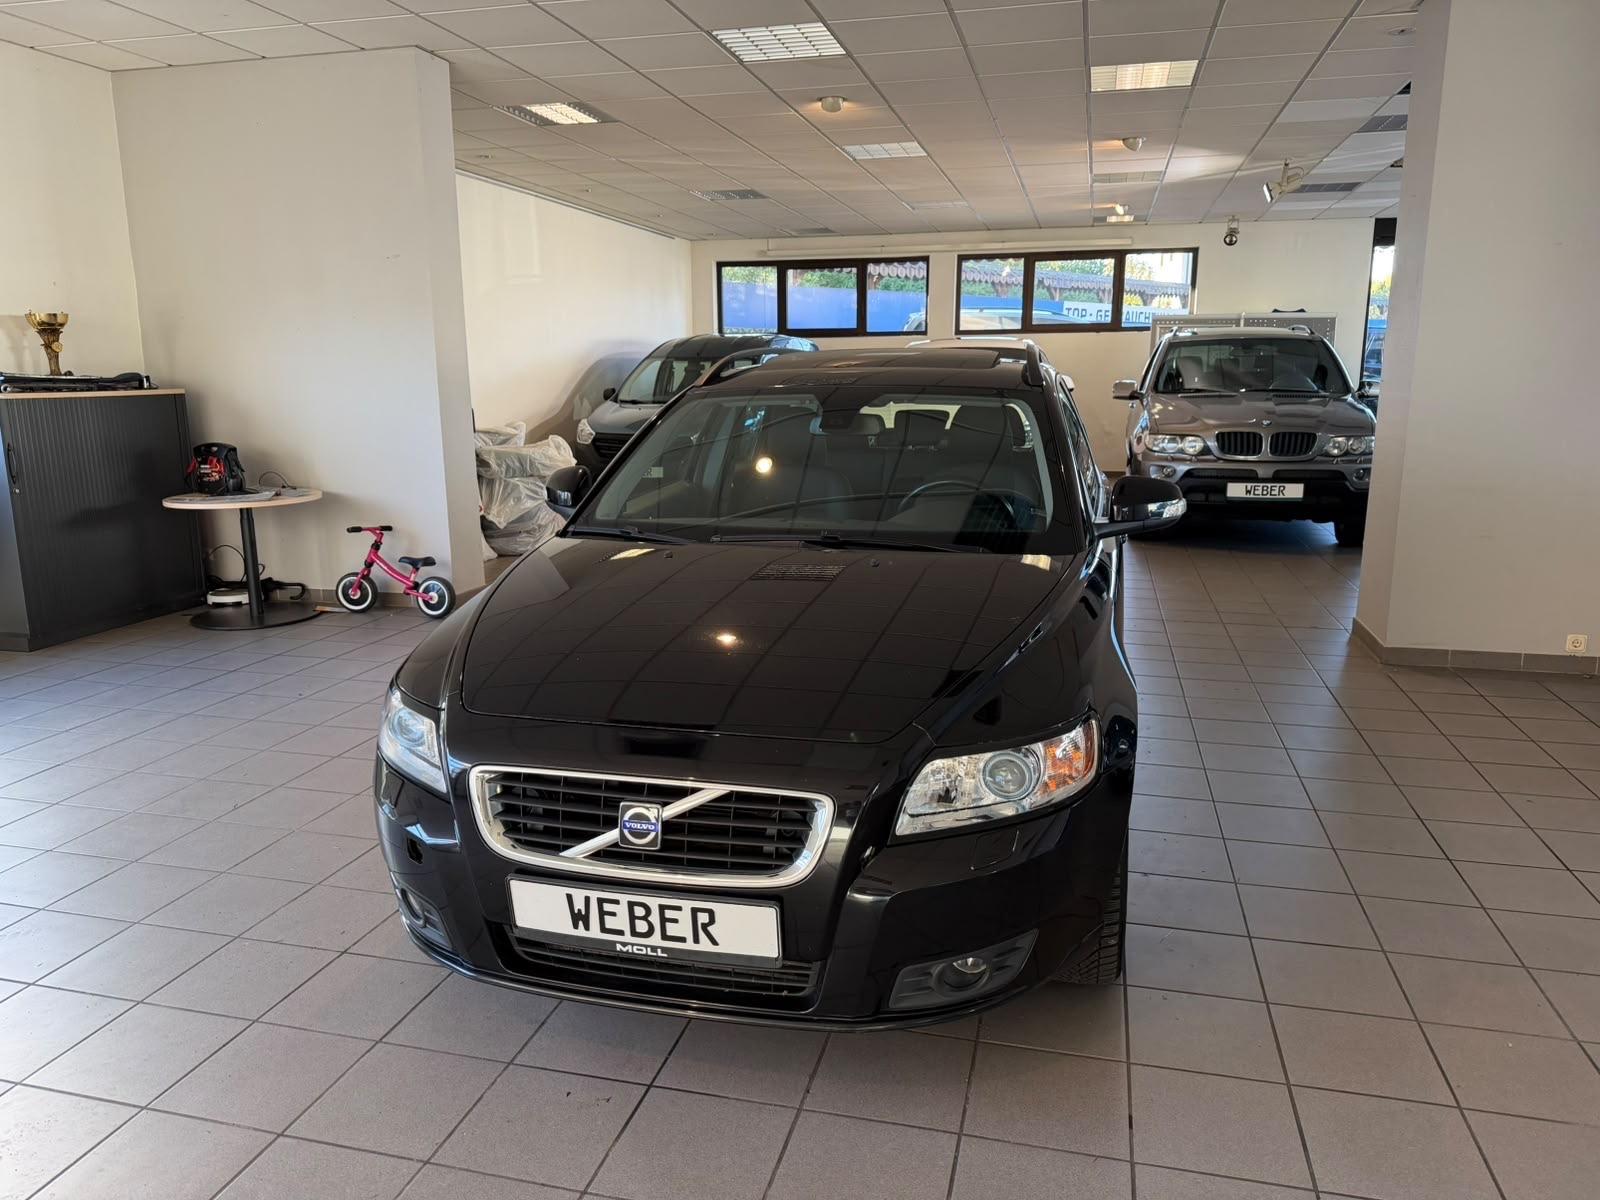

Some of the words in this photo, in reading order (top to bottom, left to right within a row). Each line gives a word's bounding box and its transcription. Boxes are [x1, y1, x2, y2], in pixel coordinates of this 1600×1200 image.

[1245, 484, 1286, 497] WEBER
[625, 822, 655, 830] VOLVO
[565, 893, 720, 947] WEBER
[616, 943, 668, 957] MOLL
